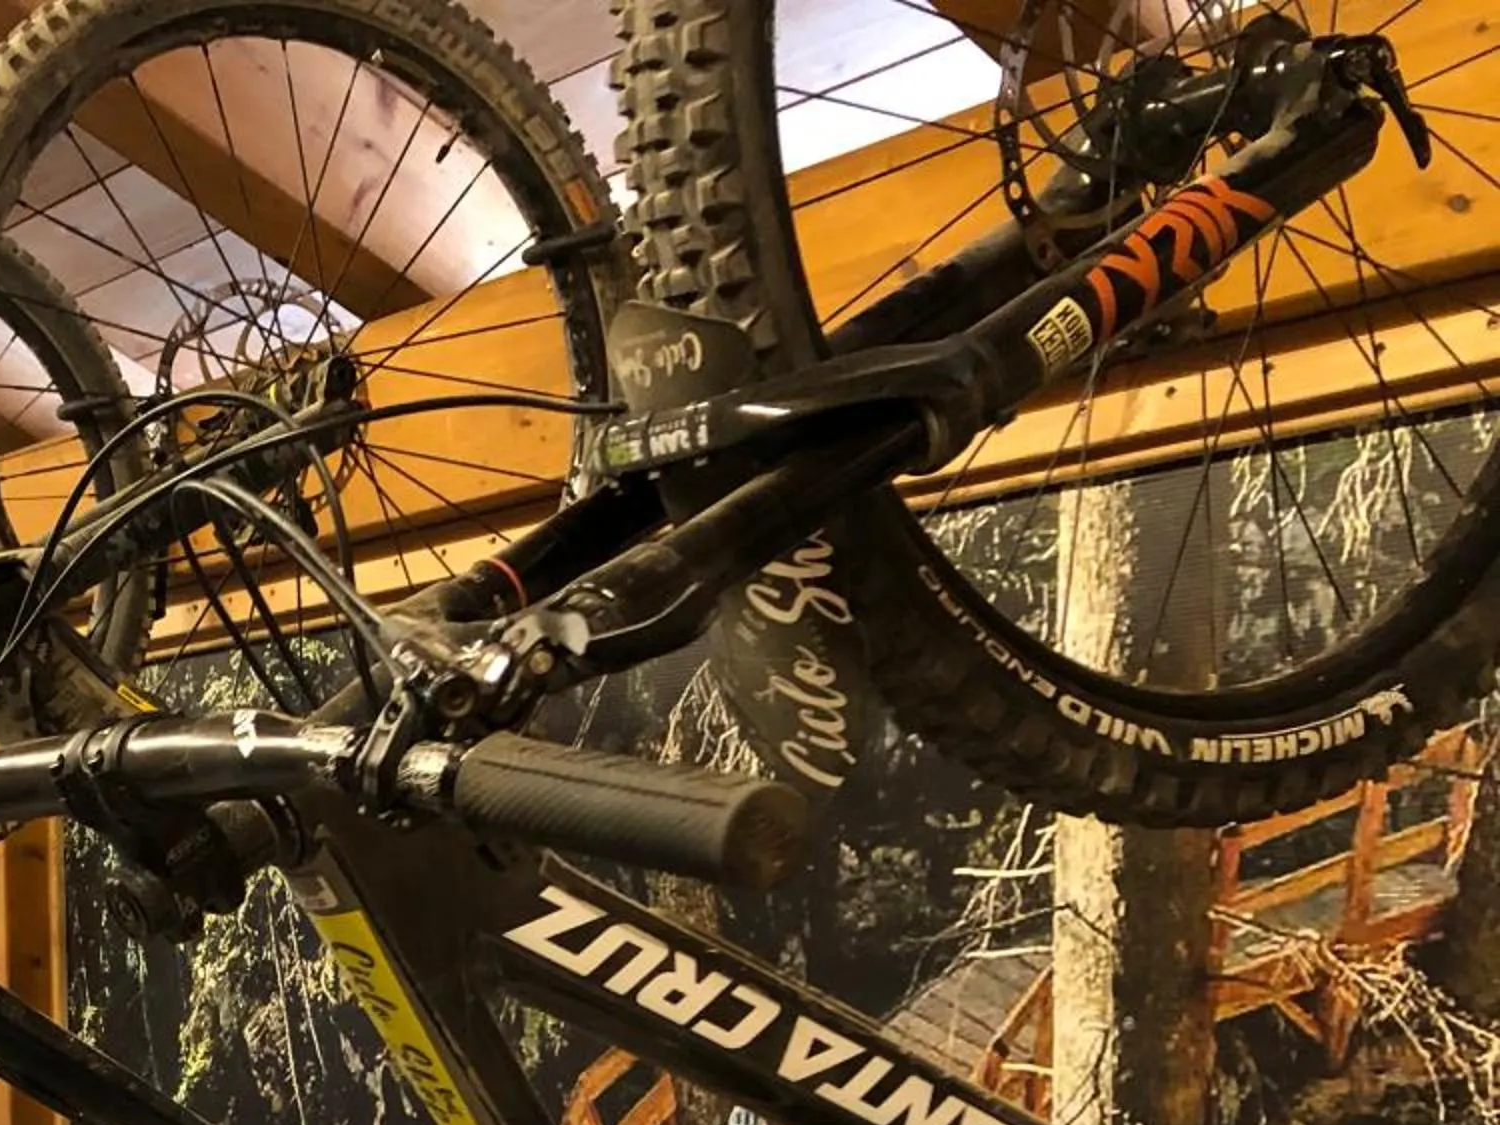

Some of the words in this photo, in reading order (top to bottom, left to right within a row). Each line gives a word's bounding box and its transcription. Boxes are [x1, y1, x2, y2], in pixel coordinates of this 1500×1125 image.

[917, 564, 1057, 700] ENDURO
[781, 644, 856, 788] Ciclo
[1056, 696, 1175, 757] WILD
[1191, 711, 1367, 764] MICHELIN
[501, 886, 782, 1050] CRUZ
